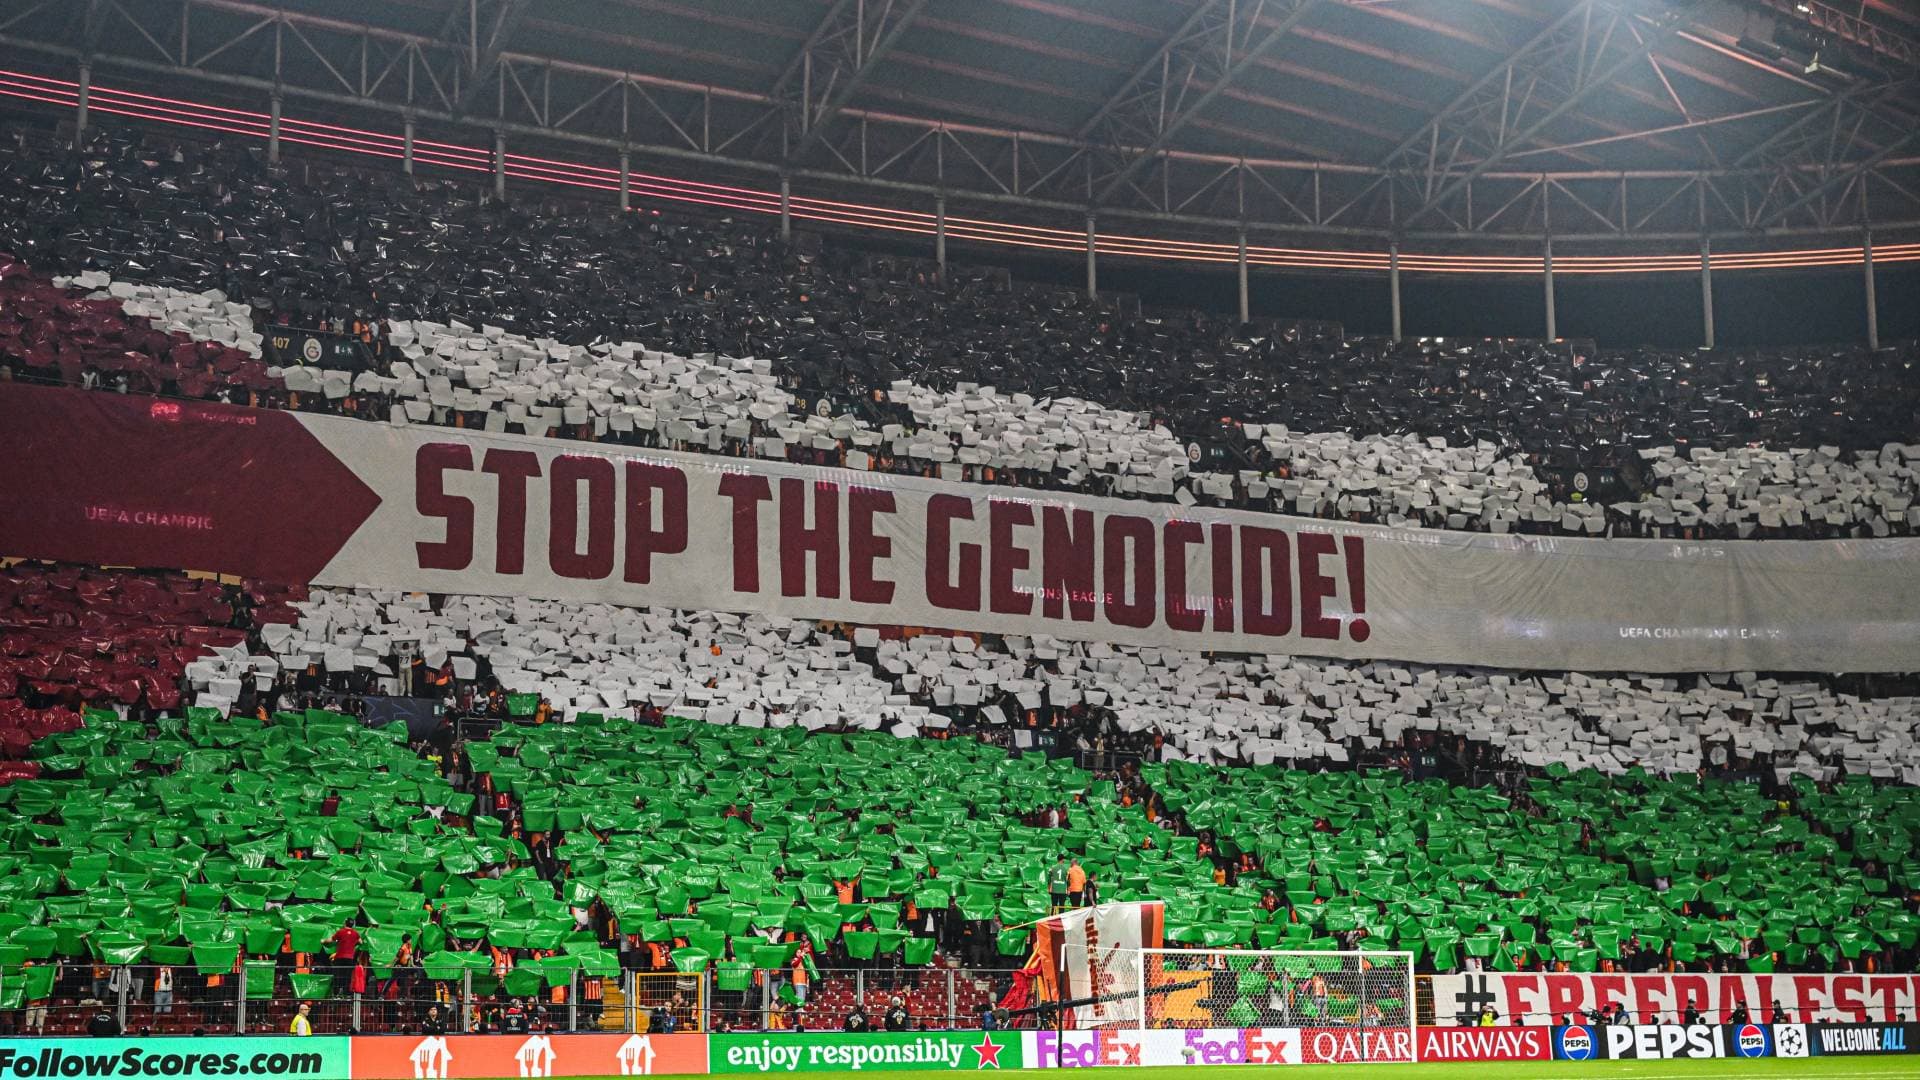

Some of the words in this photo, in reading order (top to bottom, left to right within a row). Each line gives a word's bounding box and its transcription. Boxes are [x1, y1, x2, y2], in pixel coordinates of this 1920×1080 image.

[415, 442, 689, 585] STOP
[718, 473, 897, 604] THE
[926, 493, 1371, 643] GENOCIDE!
[727, 1040, 803, 1070] enjoy
[808, 1038, 965, 1069] responsibly
[1036, 1029, 1141, 1068] FedEx
[1184, 1028, 1288, 1065] FedEx
[1313, 1031, 1412, 1062] QATAR
[1423, 1030, 1540, 1058] AIRWAYS
[1564, 1039, 1590, 1048] PEPSI
[1606, 1024, 1726, 1060] PEPSI
[1741, 1038, 1764, 1046] PEPSI
[1821, 1028, 1882, 1052] WELCOME
[1882, 1027, 1906, 1050] ALL
